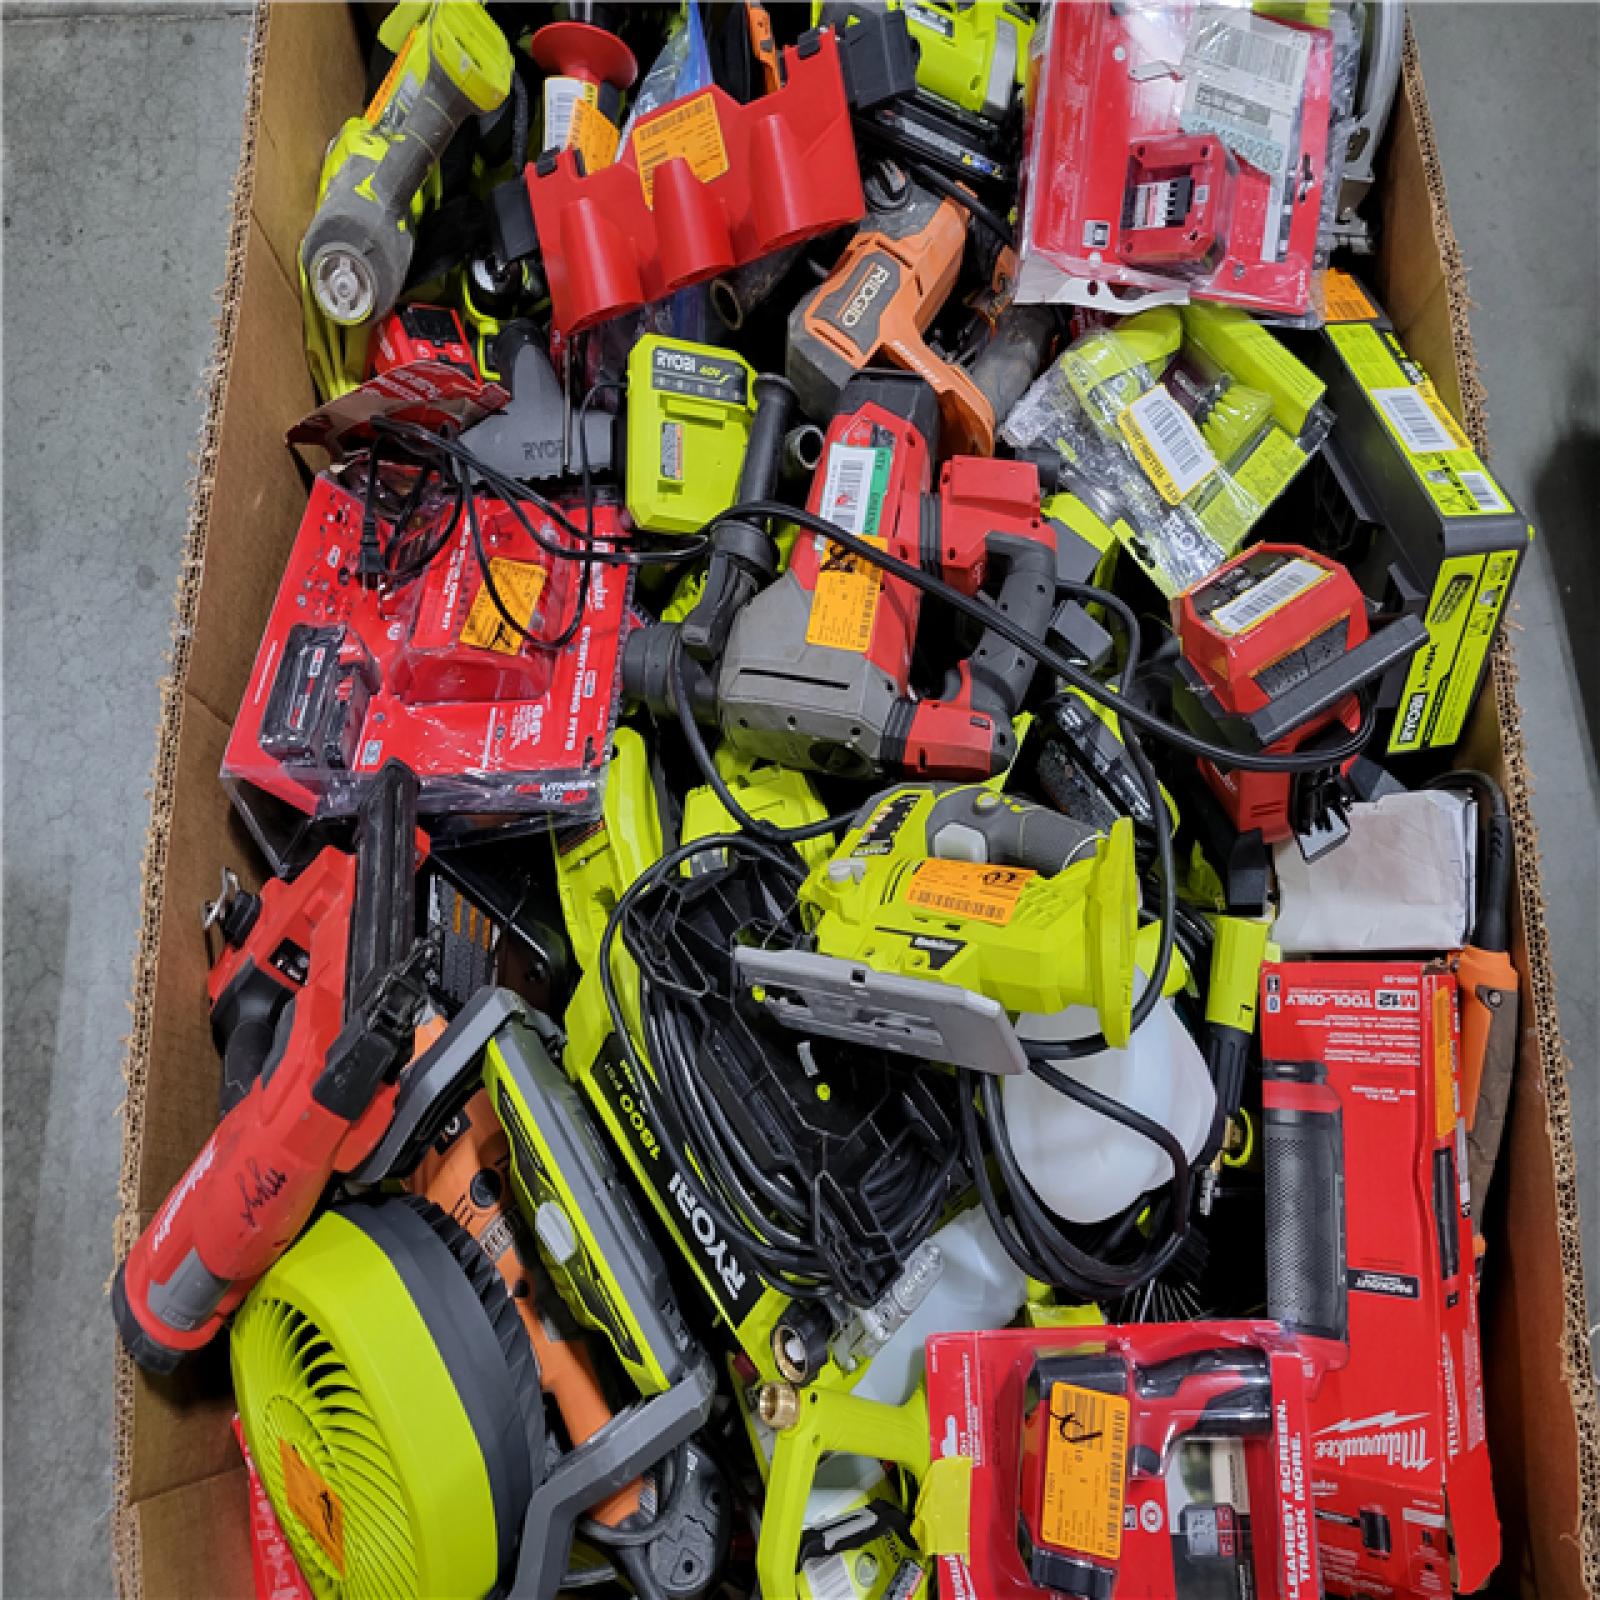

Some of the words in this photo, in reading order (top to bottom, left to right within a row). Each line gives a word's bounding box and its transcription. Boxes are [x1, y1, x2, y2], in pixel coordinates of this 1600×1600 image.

[842, 265, 891, 326] RIDGID
[656, 350, 696, 374] RYOBI
[1399, 693, 1424, 744] RYOBI
[1285, 993, 1374, 1009] TOOL-ONLY
[1378, 991, 1418, 1009] M12
[618, 1094, 662, 1160] 1800
[667, 1171, 746, 1300] RYOBI
[1290, 1432, 1306, 1501] MORE.
[1313, 1426, 1434, 1471] Milwaukee
[1294, 1507, 1311, 1582] TRACK
